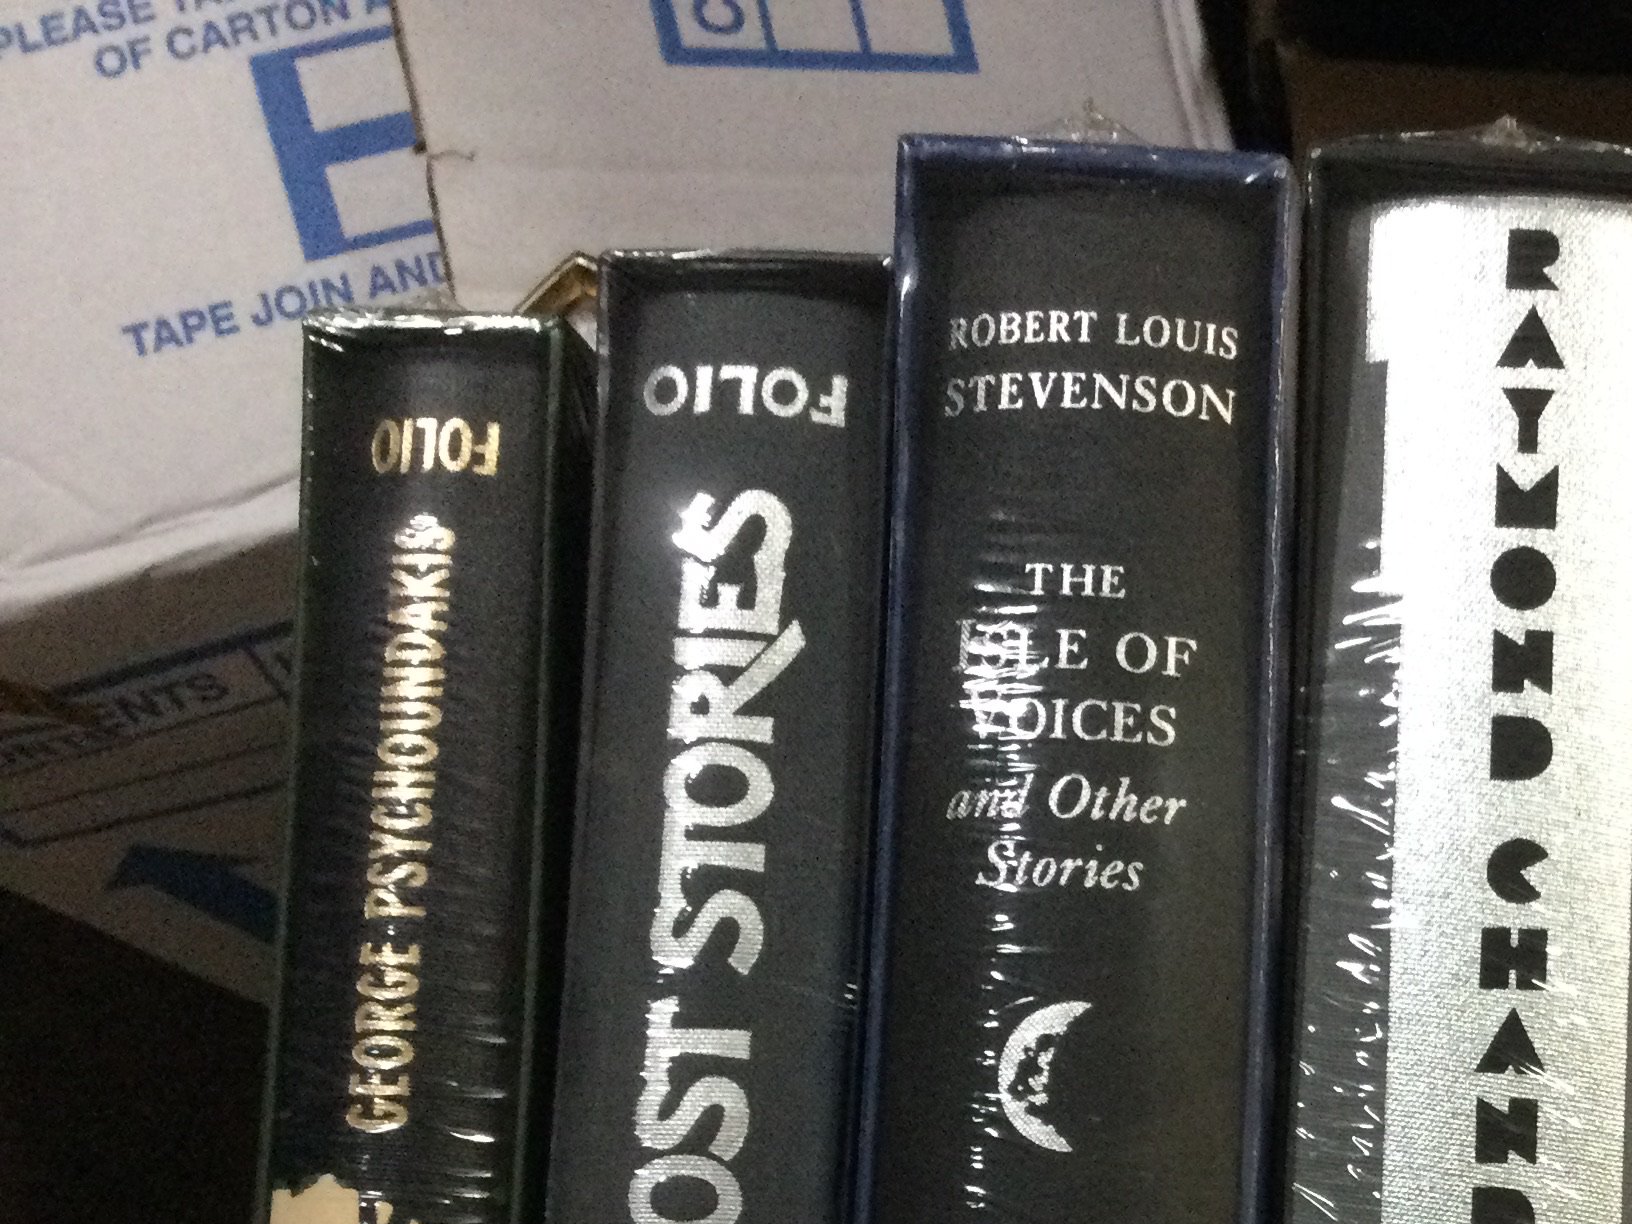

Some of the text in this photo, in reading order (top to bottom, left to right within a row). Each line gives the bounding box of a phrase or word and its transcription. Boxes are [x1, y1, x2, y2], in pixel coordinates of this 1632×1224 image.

[94, 0, 352, 78] OF CARTON
[121, 299, 241, 357] TAPE
[250, 272, 355, 327] JOIN
[947, 310, 1240, 361] ROBERT LOUIS
[644, 363, 848, 428] FOLIO
[944, 371, 1236, 426] STEVENSON
[372, 416, 501, 476] FOLIO
[1490, 228, 1565, 781] RAYMOND
[1025, 562, 1127, 600] THE
[1115, 631, 1198, 678] OF
[649, 488, 806, 979] STORIES
[970, 686, 1178, 747] VOICES
[345, 511, 458, 1134] GEORGE PSYCHOUNDAKIS
[946, 772, 1187, 825] and Other
[973, 837, 1144, 893] Stories
